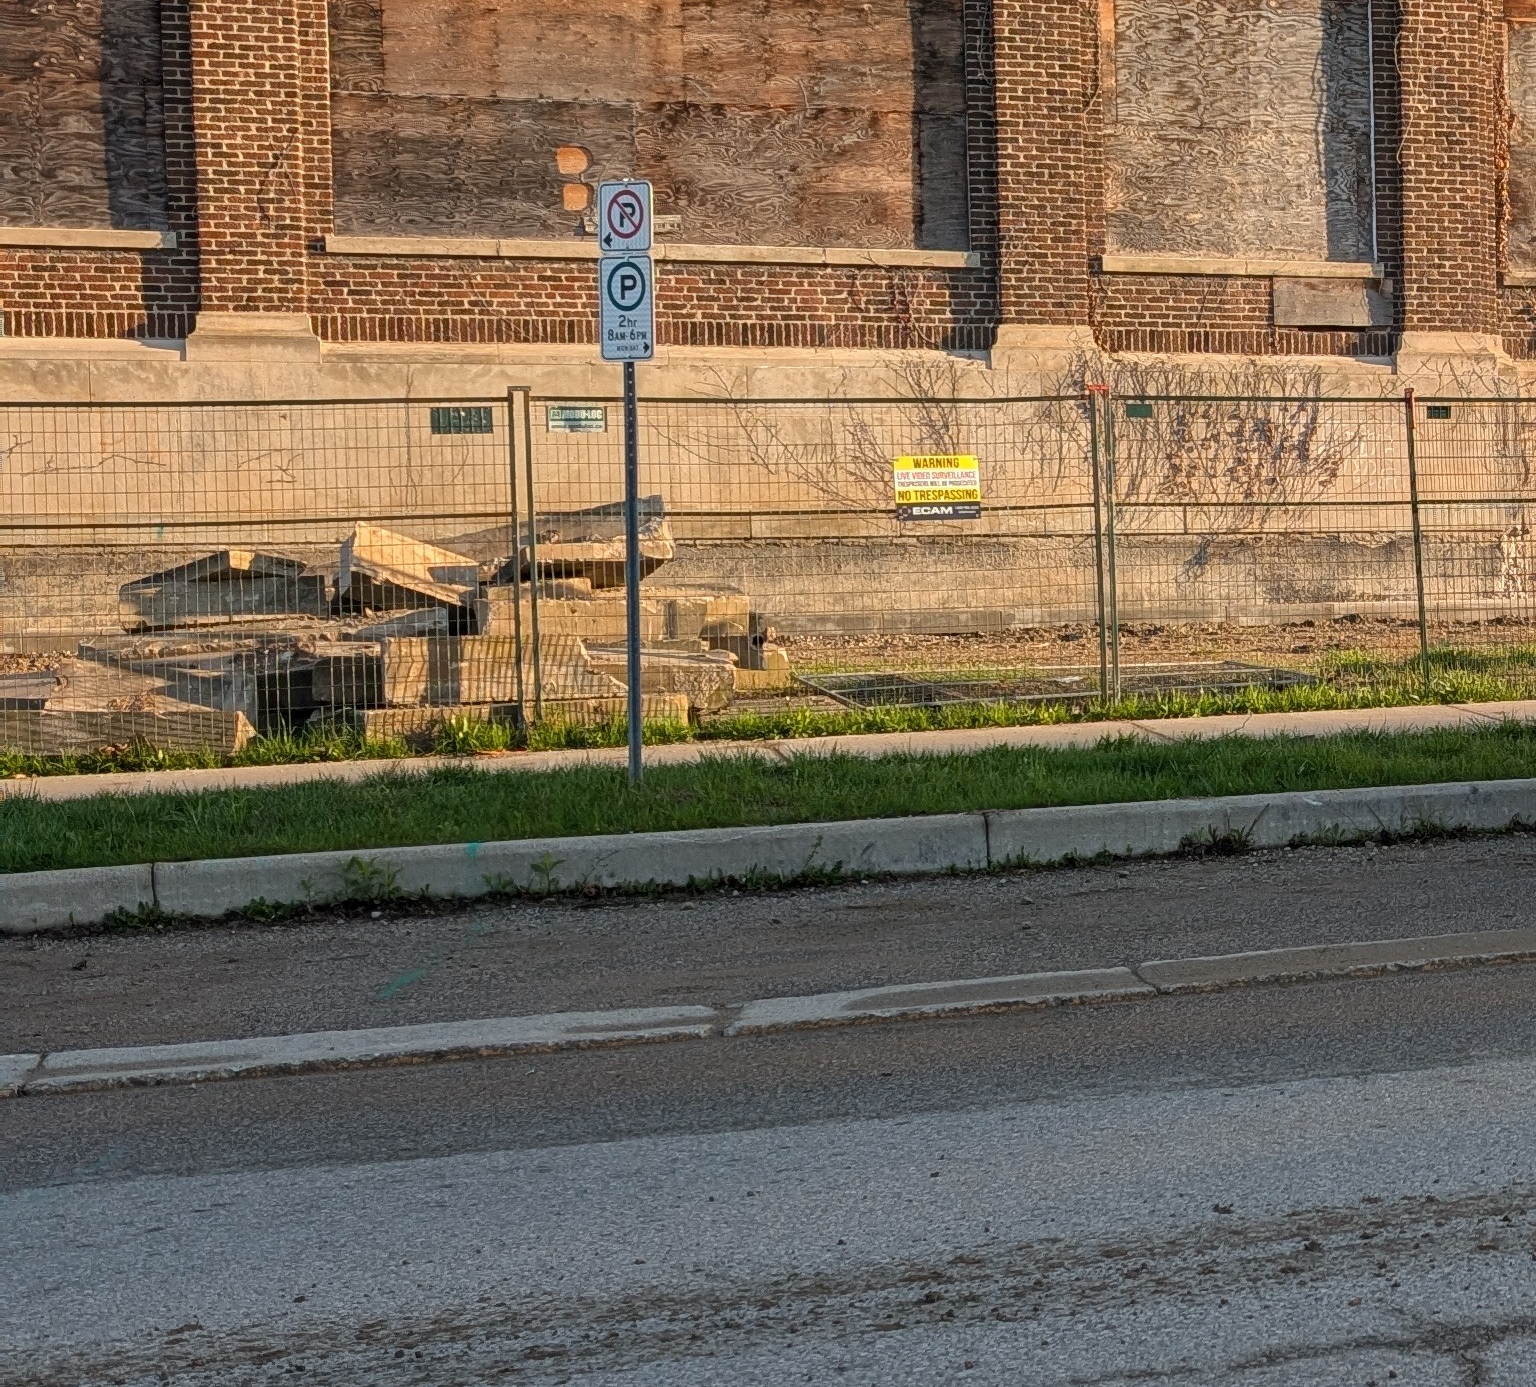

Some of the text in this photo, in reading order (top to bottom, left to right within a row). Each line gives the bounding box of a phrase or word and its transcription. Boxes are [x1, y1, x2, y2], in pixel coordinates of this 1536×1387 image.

[620, 274, 637, 300] P
[913, 457, 960, 469] WARNING
[896, 471, 976, 480] LIVE VIDEO SURVEILLANCE
[898, 489, 978, 501] NO TRESPASSING
[912, 506, 953, 515] ECAM
